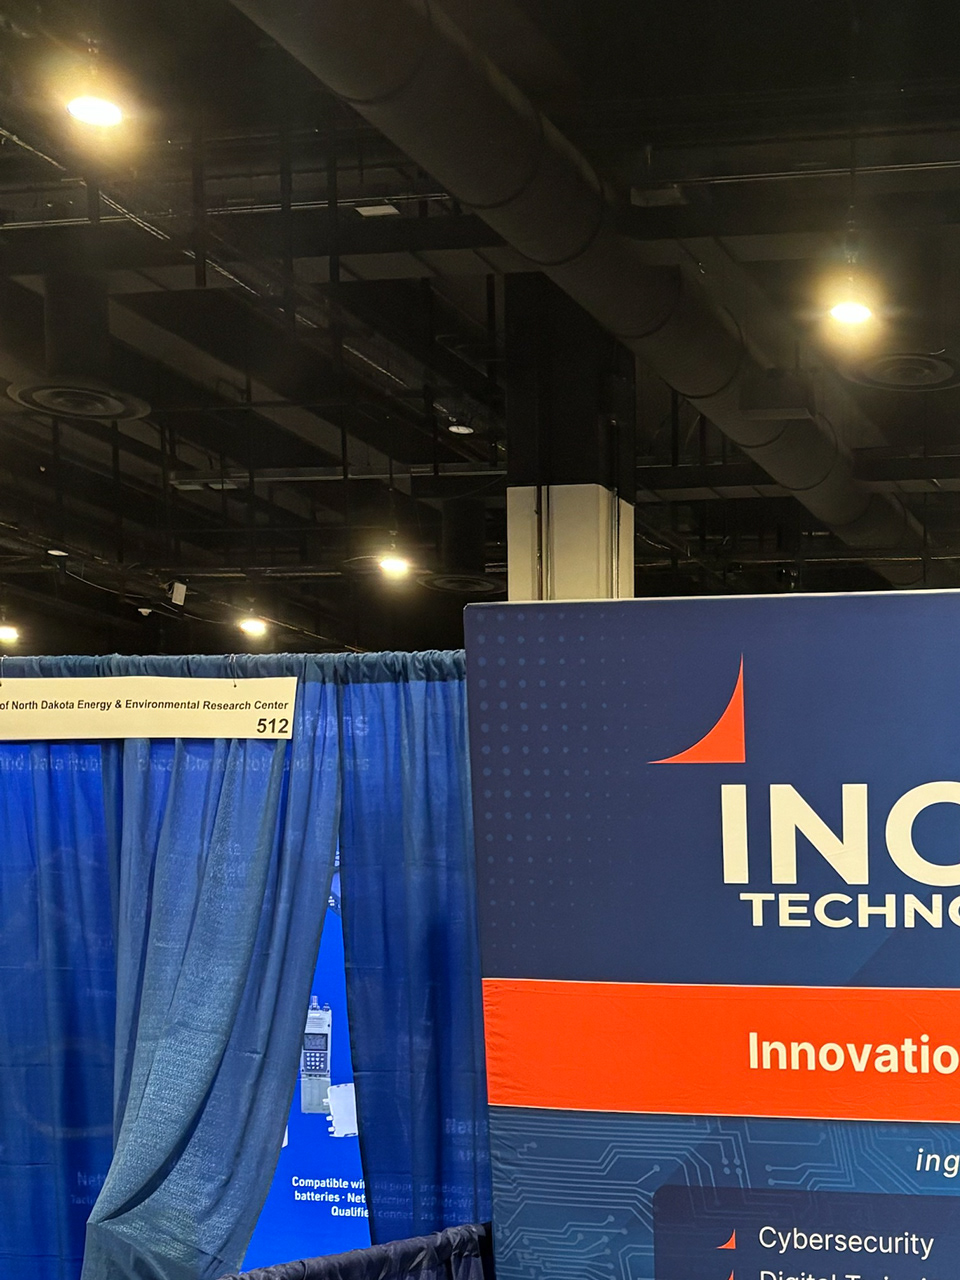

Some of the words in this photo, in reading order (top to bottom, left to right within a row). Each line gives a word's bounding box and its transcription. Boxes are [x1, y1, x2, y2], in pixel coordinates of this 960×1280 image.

[0, 700, 9, 710] of
[11, 701, 38, 710] North
[41, 700, 75, 710] Dakota
[77, 700, 112, 711] Energy
[115, 699, 122, 709] &
[125, 699, 200, 709] Environmental
[203, 701, 251, 710] Research
[254, 701, 289, 710] Center
[257, 718, 289, 733] 512
[292, 1176, 348, 1189] Compatible
[294, 1190, 340, 1203] batteries
[347, 1193, 366, 1203] Net
[331, 1206, 369, 1218] Qualifie
[759, 1227, 934, 1260] Cybersecurity
